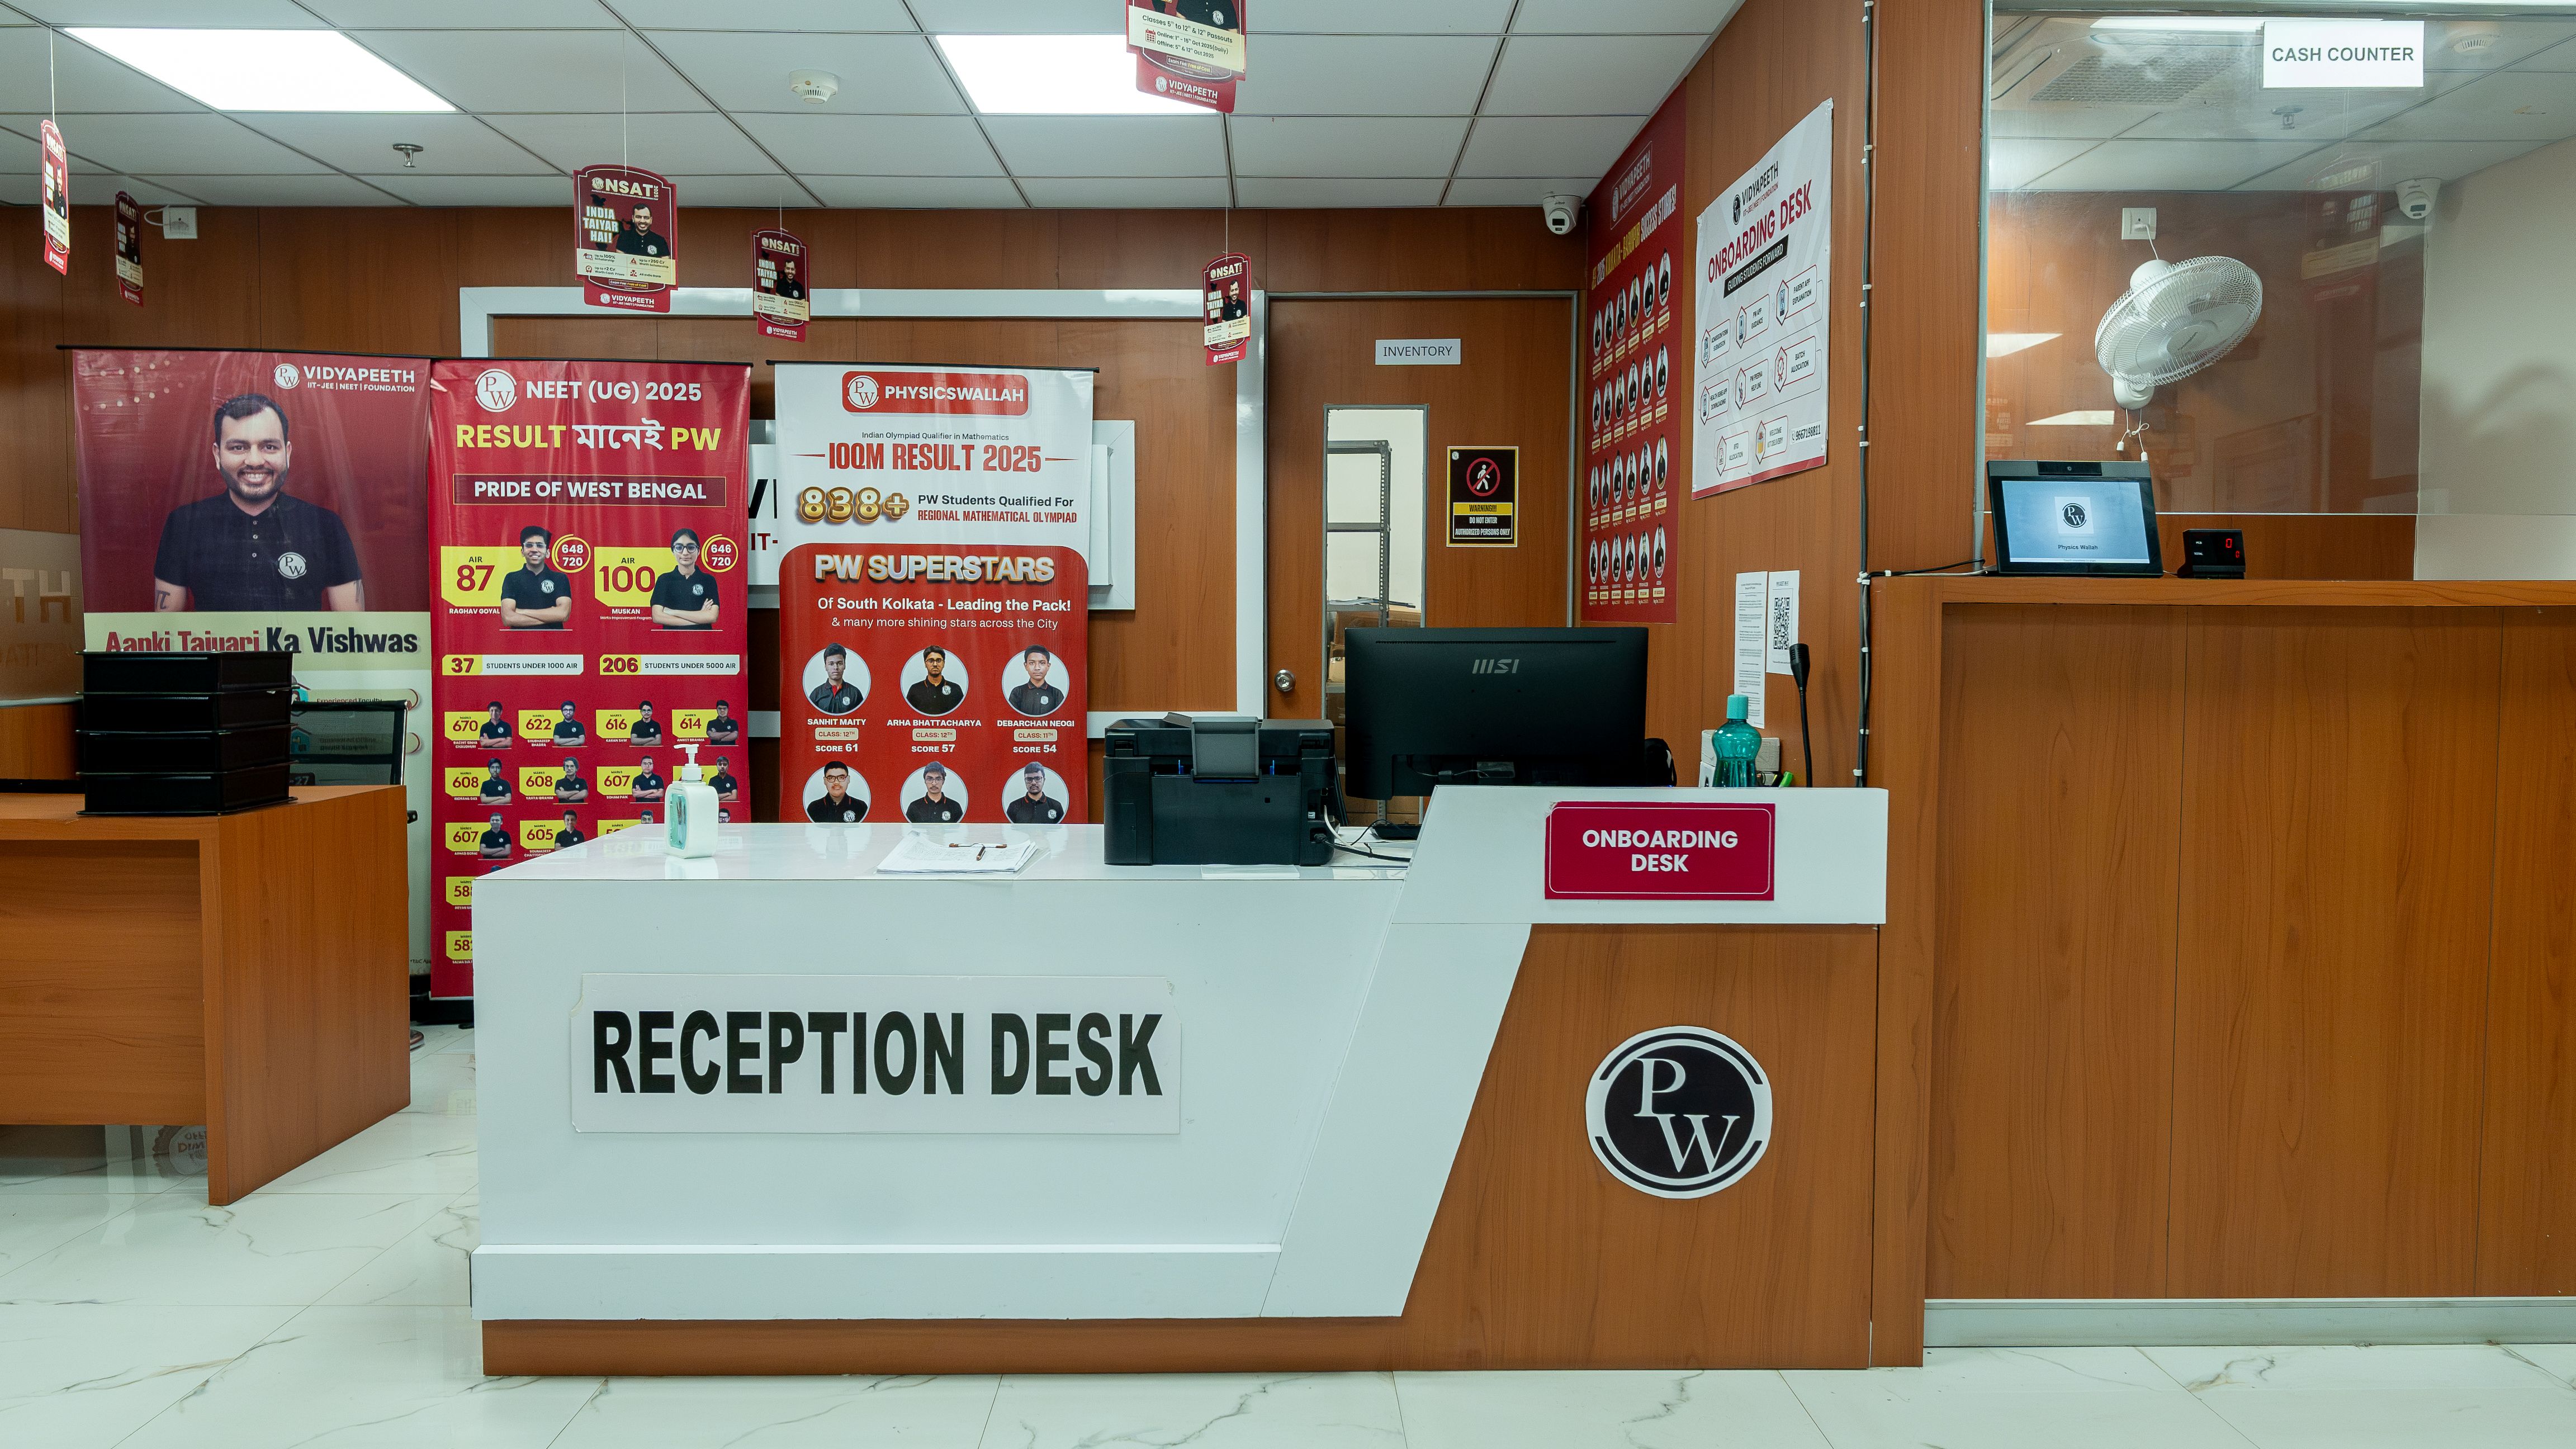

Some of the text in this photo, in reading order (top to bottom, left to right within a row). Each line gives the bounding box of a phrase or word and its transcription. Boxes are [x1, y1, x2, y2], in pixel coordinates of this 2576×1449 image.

[1142, 15, 1166, 26] Classes
[1207, 32, 1233, 43] Passouts
[1157, 31, 1175, 40] Online:
[1157, 40, 1175, 49] Offline:
[2272, 48, 2414, 61] CASH COUNTER
[1169, 79, 1218, 99] VIDYAPEETH
[1194, 94, 1217, 105] FOUNDATION
[1620, 150, 1650, 200] VIDYAPEETH
[1742, 160, 1778, 206] VIDYAPEETH
[586, 206, 615, 220] INDIA
[583, 217, 619, 233] TAIYAR
[1708, 210, 1775, 283] ONBOARDING
[1781, 179, 1812, 231] DESK
[590, 231, 612, 243] HAI!
[1727, 244, 1783, 291] GUIDING STUDENTS FORWARD
[1793, 282, 1805, 293] PARENT
[612, 295, 655, 304] VIDYAPEETH
[1793, 290, 1812, 305] EXPLANATION
[1383, 346, 1452, 357] INVENTORY
[1795, 351, 1805, 361] BATCH
[1791, 360, 1809, 373] ALLOCATION
[303, 366, 415, 383] VIDYAPEETH
[307, 382, 334, 390] IIT-JEE
[363, 384, 415, 392] FOUNDATION
[527, 380, 702, 404] NEET (UG) 2025
[884, 386, 1024, 402] PHYSICSWALLAH
[456, 425, 567, 448] RESULT
[572, 418, 665, 451] মানেই
[671, 428, 721, 451] PW
[886, 432, 920, 441] Olympiad
[921, 432, 951, 441] Qualifier
[829, 443, 1041, 472] IOQM RESULT 2025
[475, 481, 706, 499] PRIDE OF WEST BENGAL
[798, 486, 910, 523] 838+
[918, 495, 1074, 508] PW Students Qualified For
[917, 510, 1077, 523] REGIONAL MATHEMATICAL OLYMPIAD
[562, 544, 583, 553] 648
[711, 544, 731, 553] 646
[2225, 538, 2232, 548] 0
[562, 557, 583, 567] 720
[712, 557, 731, 566] 720
[815, 555, 1054, 581] PW SUPERSTARS
[456, 565, 495, 591] 87
[599, 566, 655, 593] 100
[818, 598, 1071, 613] Of South Kolkata Leading the Pack!
[832, 618, 840, 627] &
[844, 619, 873, 629] many
[908, 618, 947, 629] shining
[950, 618, 976, 628] stars
[1017, 618, 1034, 628] the
[1037, 618, 1058, 630] City
[266, 627, 300, 652] Ka
[308, 627, 418, 653] Vishwas
[451, 658, 474, 673] 37
[603, 657, 639, 673] 206
[1472, 660, 1519, 674] MSI
[453, 721, 478, 731] 670
[526, 719, 552, 730] 622
[605, 719, 627, 730] 616
[680, 718, 702, 729] 614
[845, 744, 859, 752] 61
[942, 744, 955, 752] 57
[453, 776, 479, 788] 608
[526, 775, 553, 787] 608
[604, 775, 630, 787] 607
[453, 831, 479, 843] 607
[527, 829, 553, 841] 605
[1583, 830, 1738, 848] ONBOARDING
[1632, 854, 1688, 872] DESK
[454, 886, 472, 897] 58
[593, 1010, 1163, 1097] RECEPTION DESK
